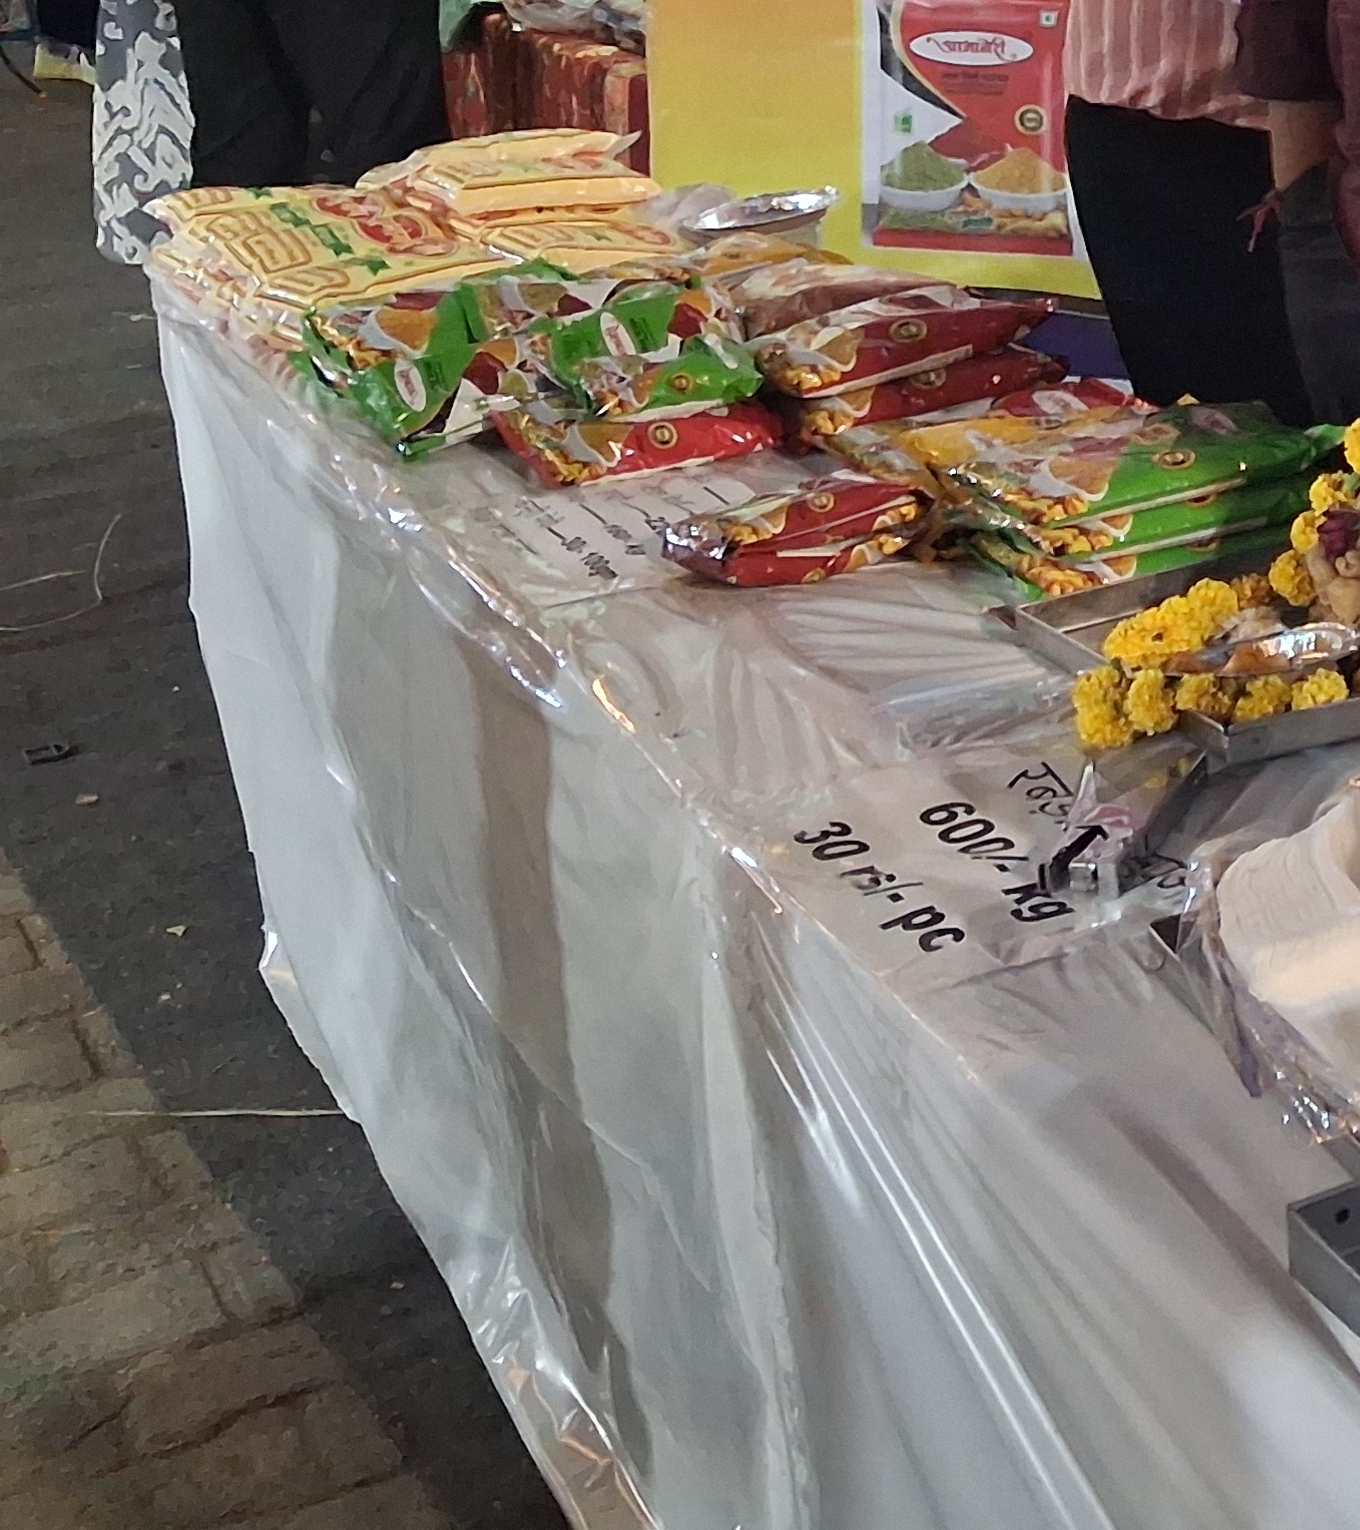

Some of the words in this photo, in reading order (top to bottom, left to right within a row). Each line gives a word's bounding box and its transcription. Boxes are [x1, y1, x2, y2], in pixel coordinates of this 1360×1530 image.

[793, 821, 871, 861] 30
[879, 904, 966, 953] pc
[919, 801, 1029, 874] 600/-
